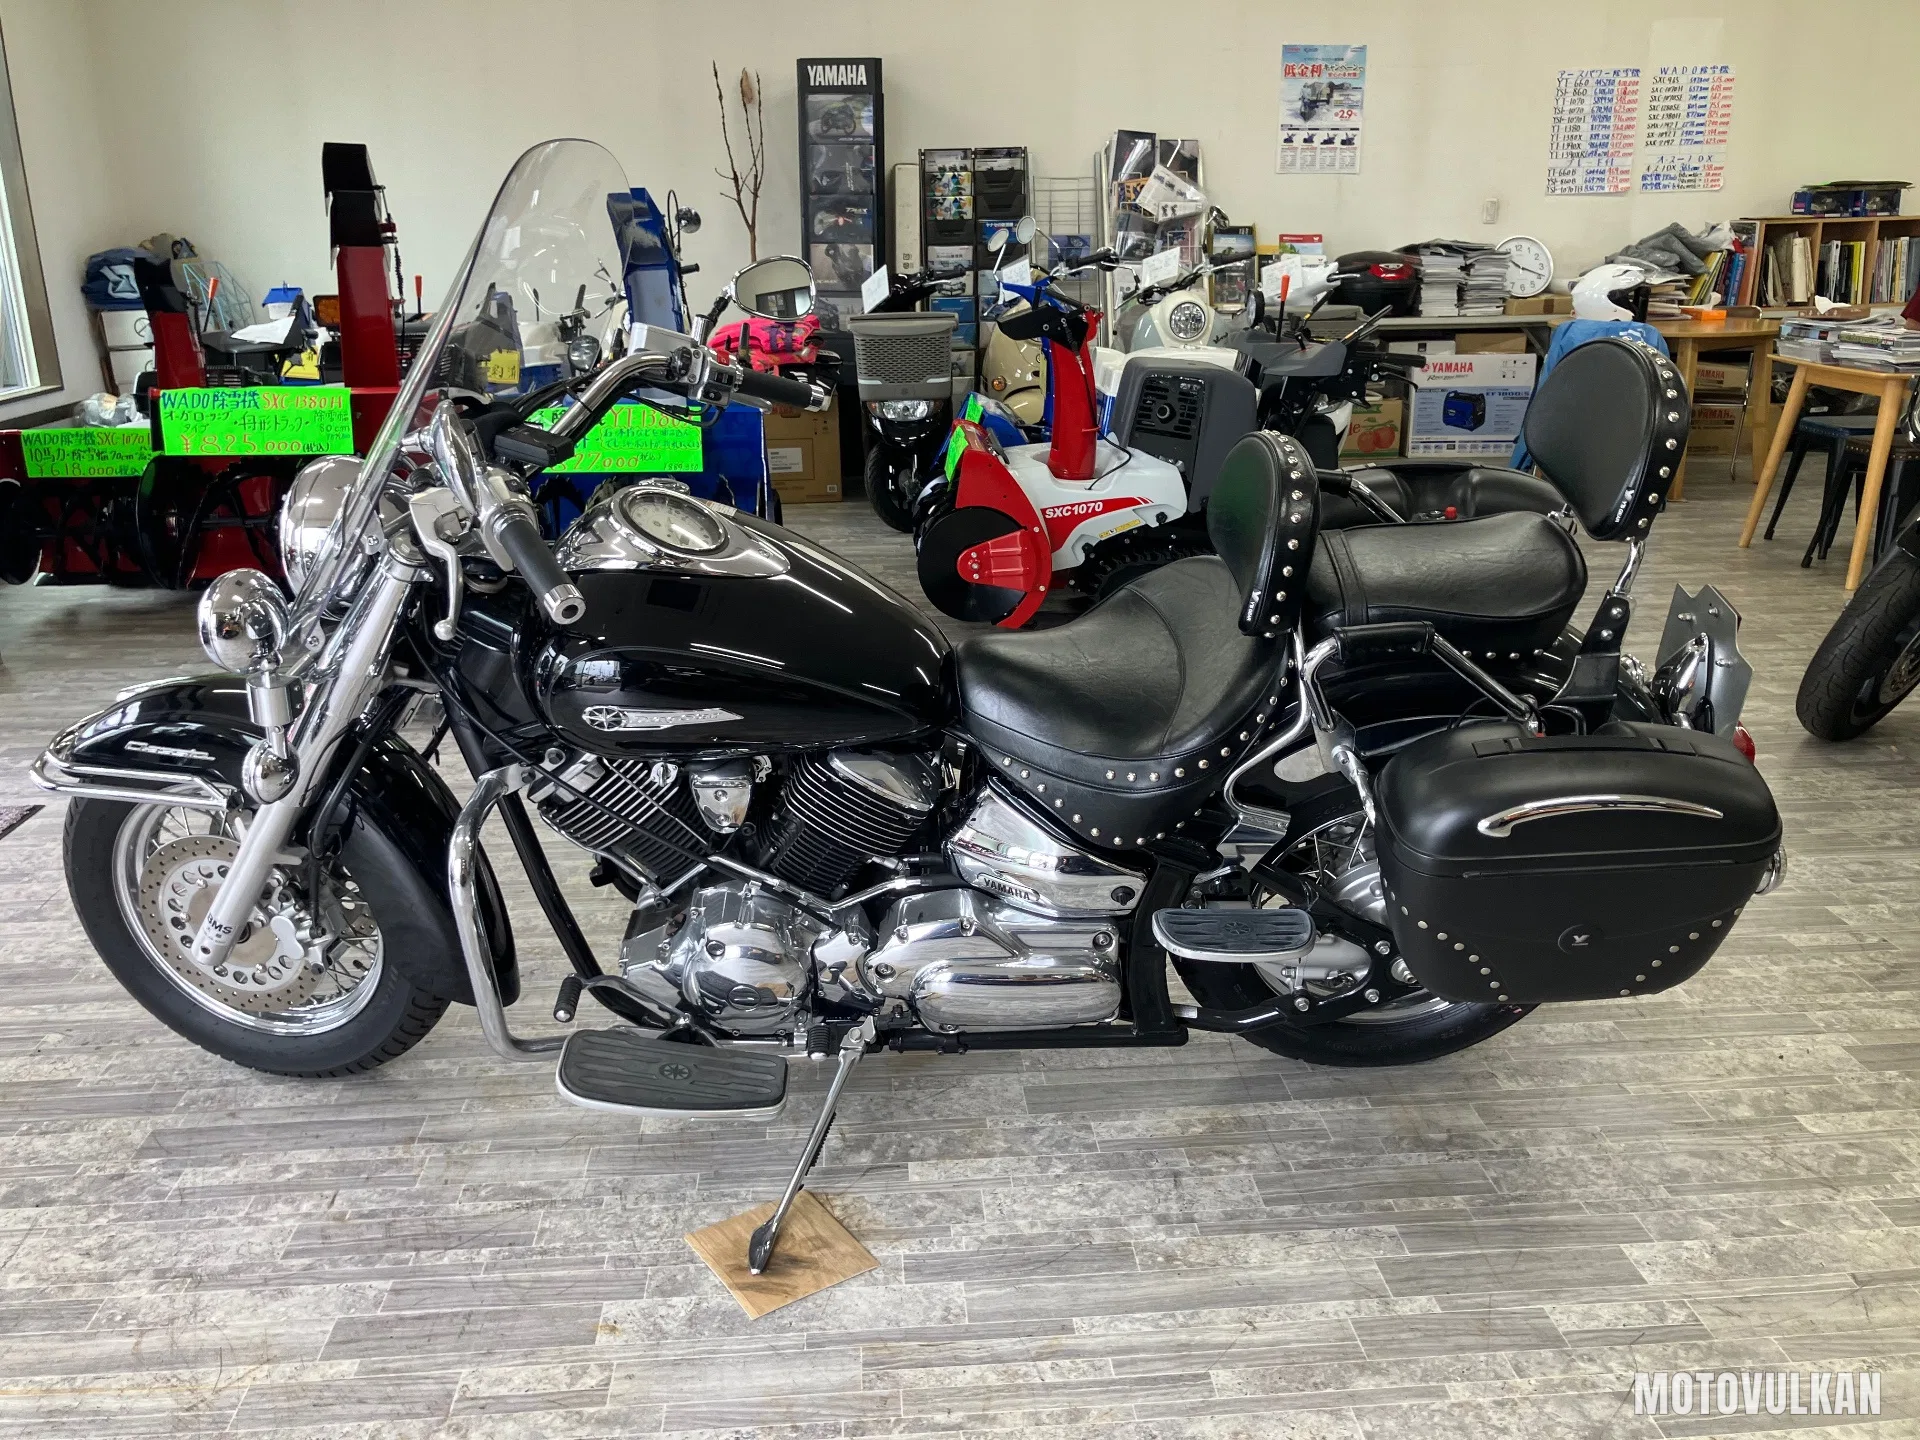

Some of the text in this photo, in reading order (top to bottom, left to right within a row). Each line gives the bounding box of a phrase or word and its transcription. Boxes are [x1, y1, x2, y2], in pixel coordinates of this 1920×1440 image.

[807, 64, 867, 87] YAMAHA
[1284, 63, 1323, 78] 低金利
[1515, 244, 1523, 253] 12
[1534, 253, 1540, 261] 2
[1510, 281, 1516, 290] 7
[1520, 284, 1526, 292] 6
[1530, 281, 1536, 289] 5
[1432, 362, 1474, 373] YAMAHA
[1045, 502, 1104, 519] SXC1070
[984, 877, 1031, 901] YAMAHA
